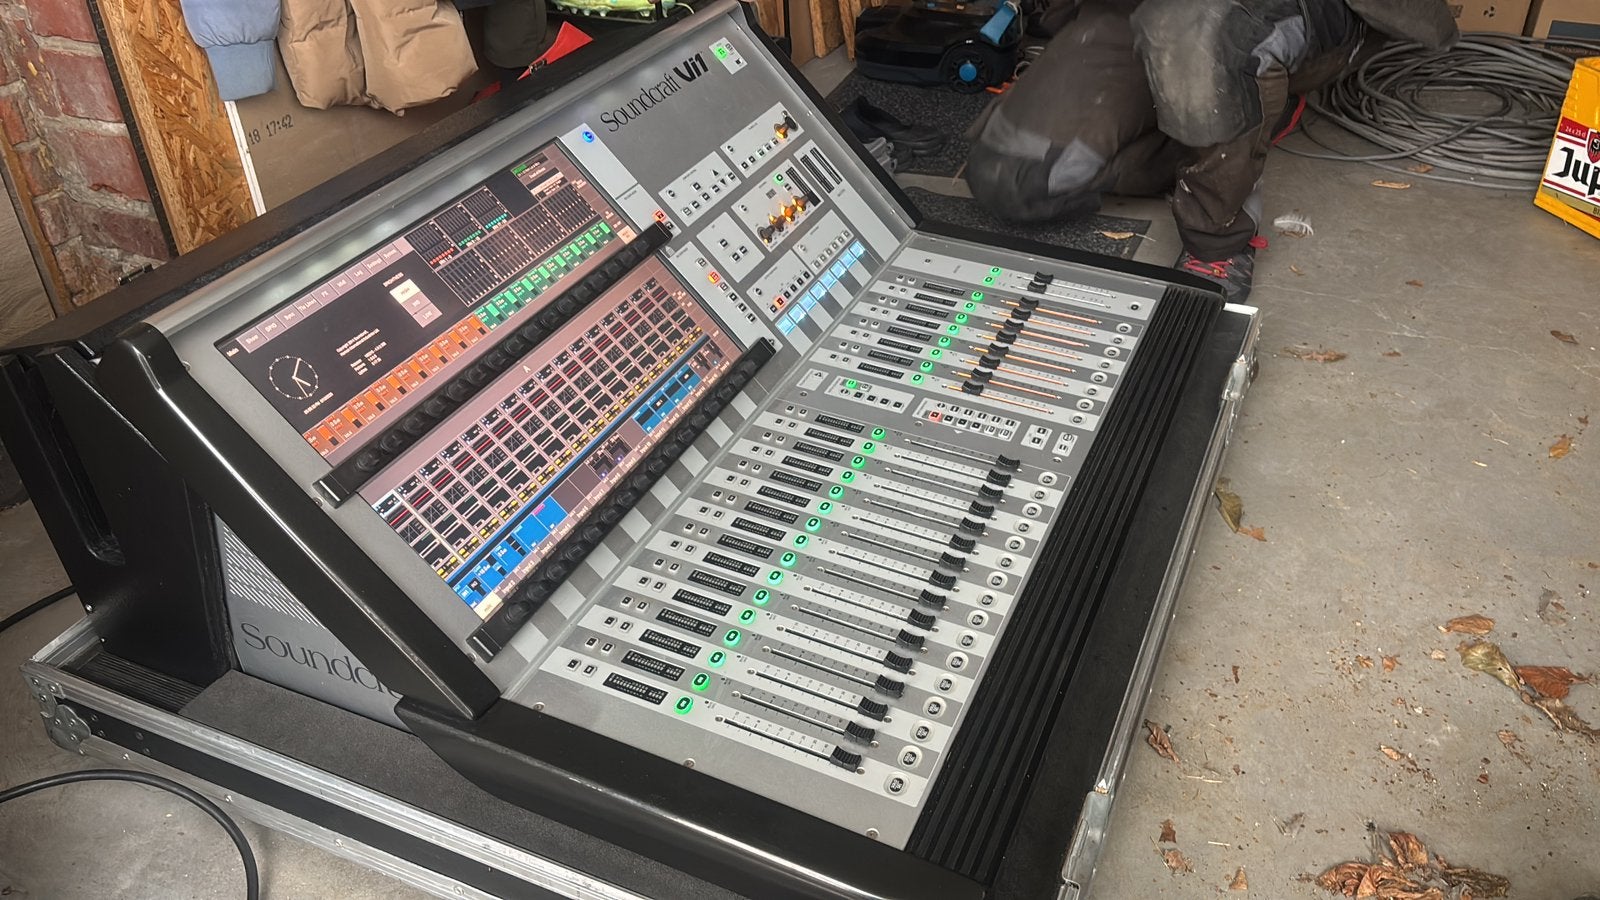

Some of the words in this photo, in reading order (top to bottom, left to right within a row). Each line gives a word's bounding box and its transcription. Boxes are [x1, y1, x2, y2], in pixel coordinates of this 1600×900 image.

[249, 129, 260, 145] 18
[266, 114, 294, 137] 17:42
[600, 73, 681, 132] Soundcraft
[673, 52, 709, 83] Vi1
[240, 622, 402, 699] Soundc
